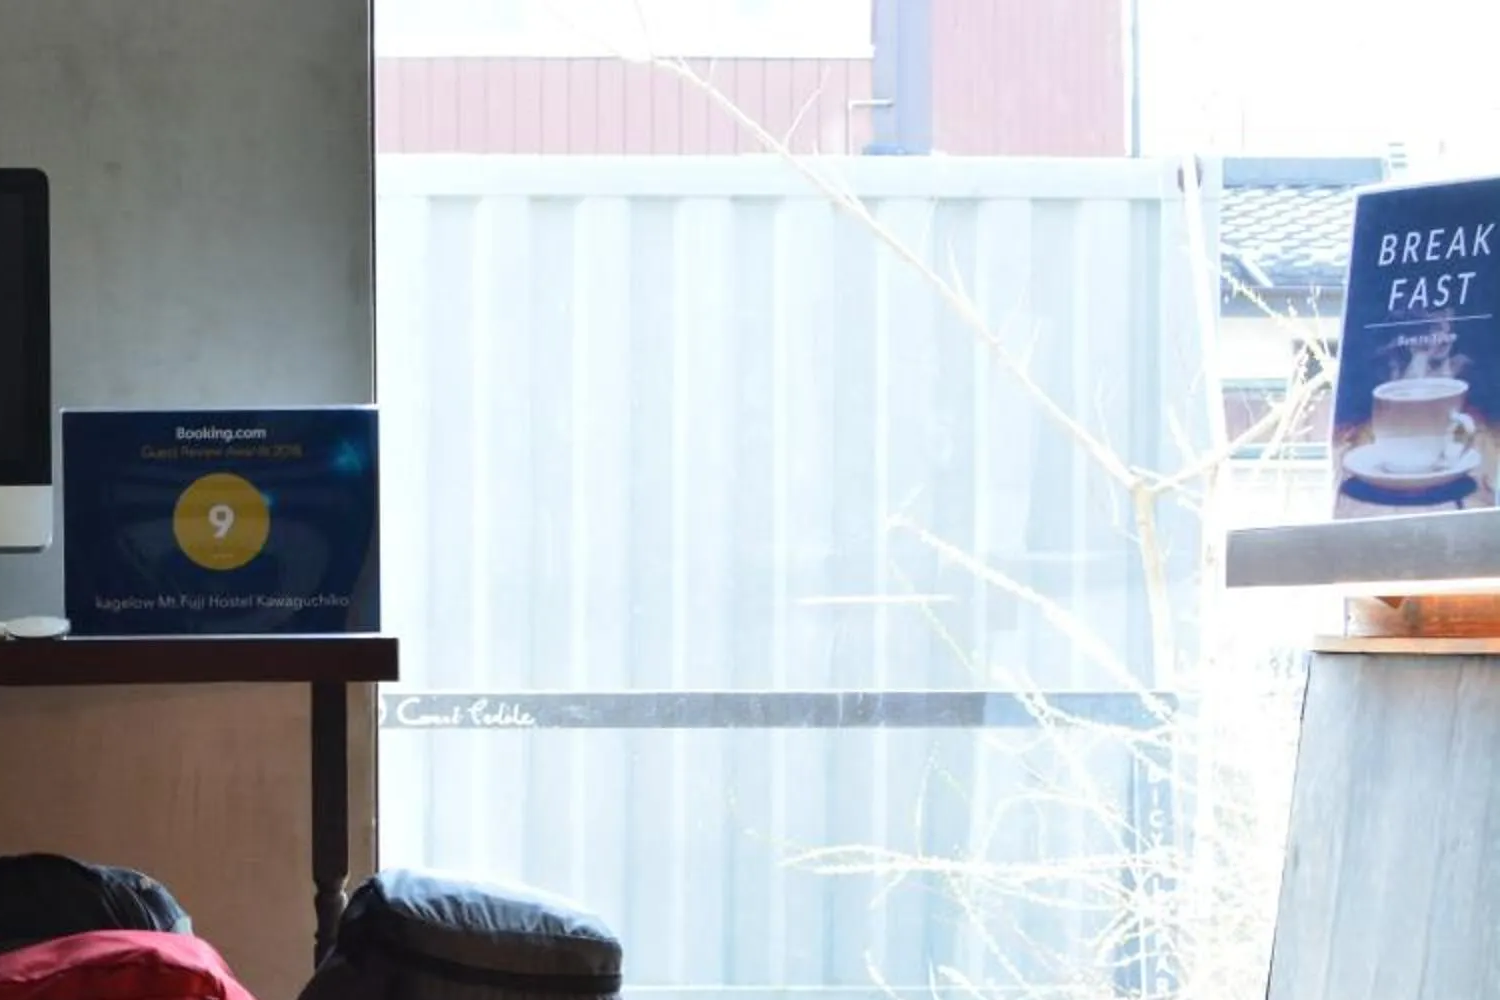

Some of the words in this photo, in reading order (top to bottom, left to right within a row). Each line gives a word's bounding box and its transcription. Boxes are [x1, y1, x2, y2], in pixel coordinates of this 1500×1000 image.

[1378, 223, 1495, 266] BREAK
[1388, 272, 1476, 311] FAST
[175, 426, 266, 443] Booking.com
[208, 503, 235, 539] 9
[209, 593, 253, 609] Hostel
[257, 593, 350, 612] Kawaguchiko
